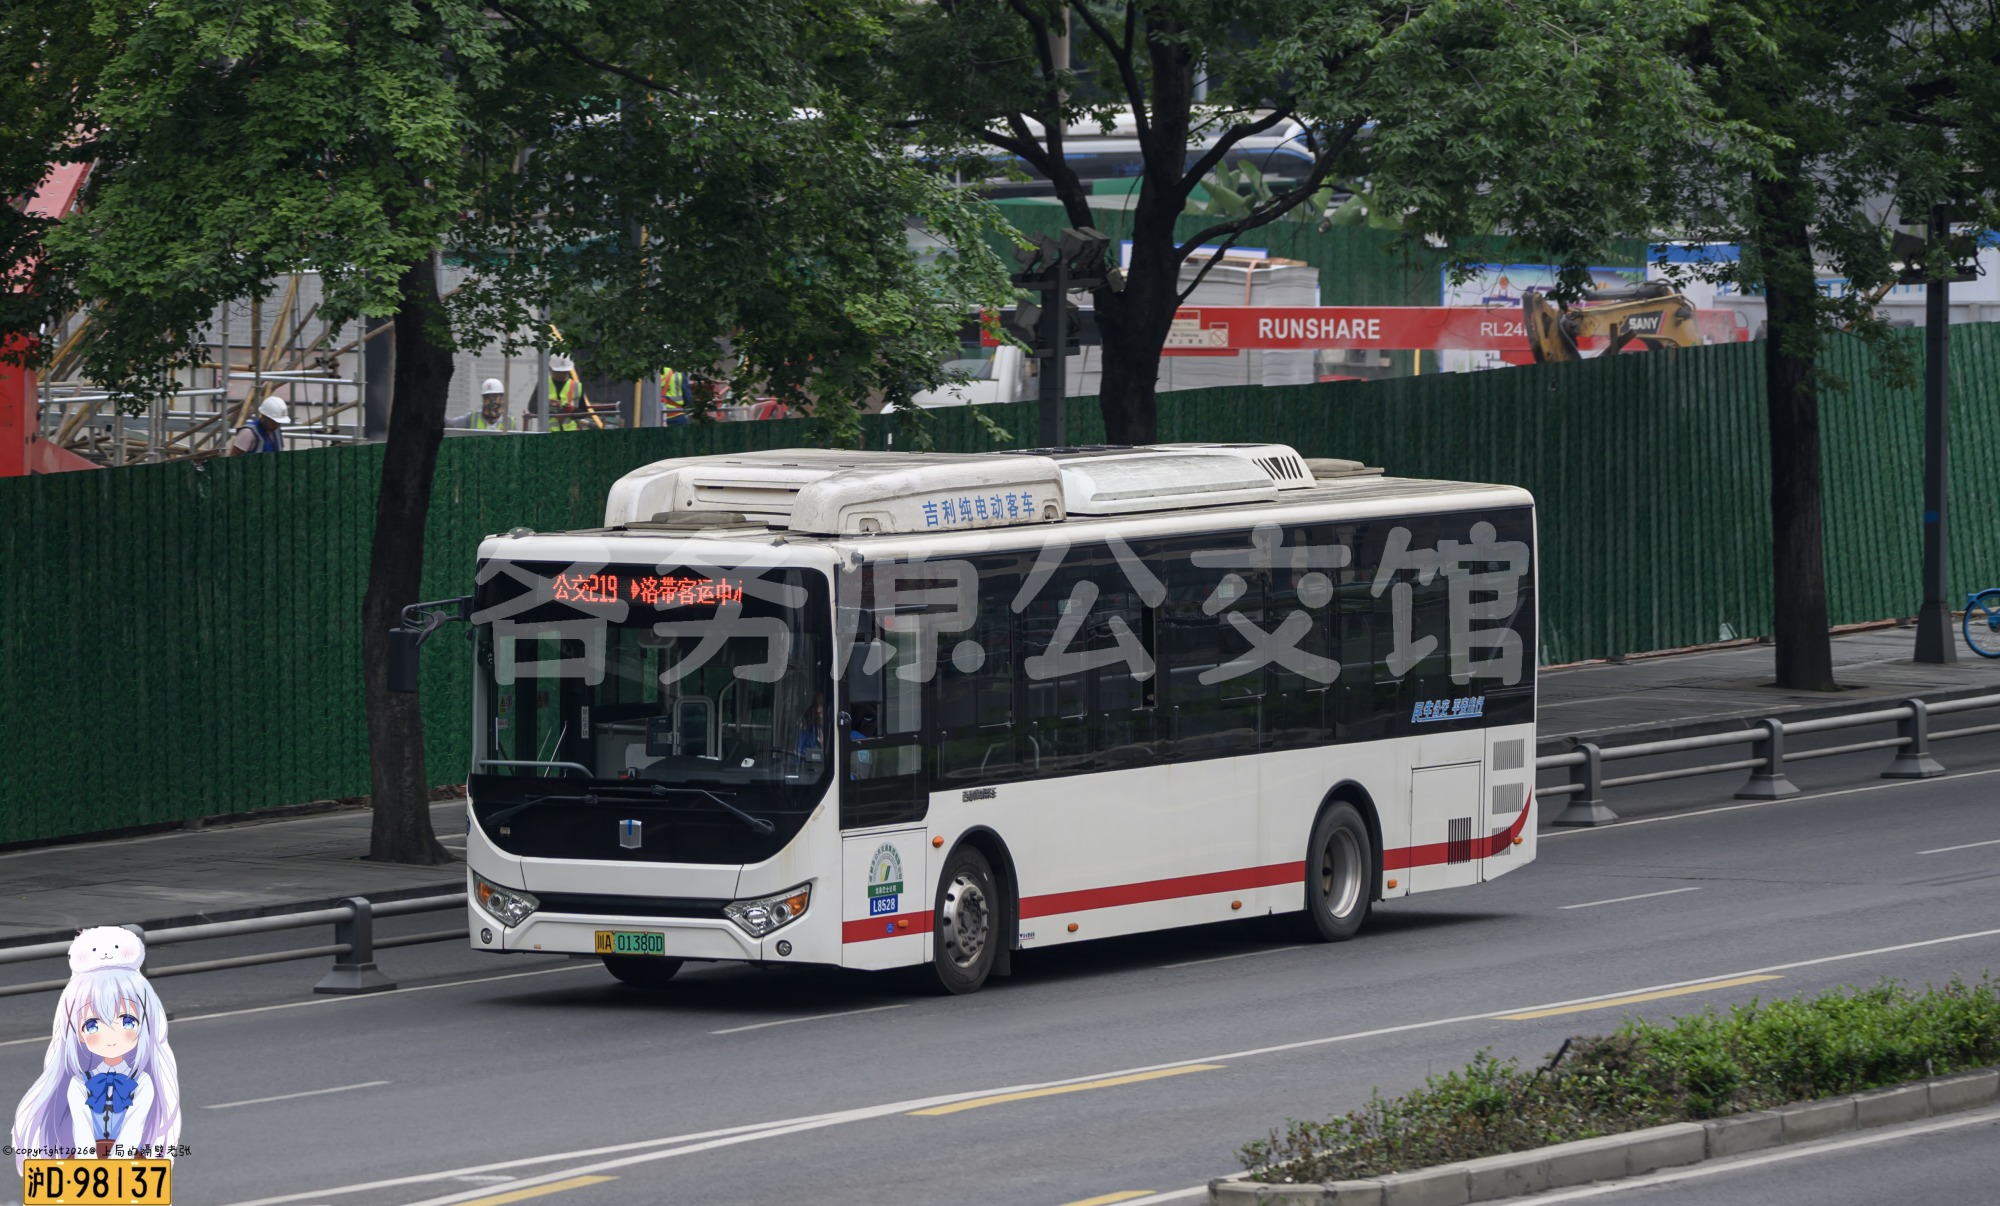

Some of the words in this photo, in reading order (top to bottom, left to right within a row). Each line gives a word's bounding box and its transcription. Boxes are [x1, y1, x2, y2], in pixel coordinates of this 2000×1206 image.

[1258, 318, 1381, 340] RUNSHARE
[1628, 316, 1659, 332] SANY
[922, 491, 1035, 528] 吉利纯电动客车
[552, 573, 618, 603] 公交219
[873, 898, 896, 913] L8528
